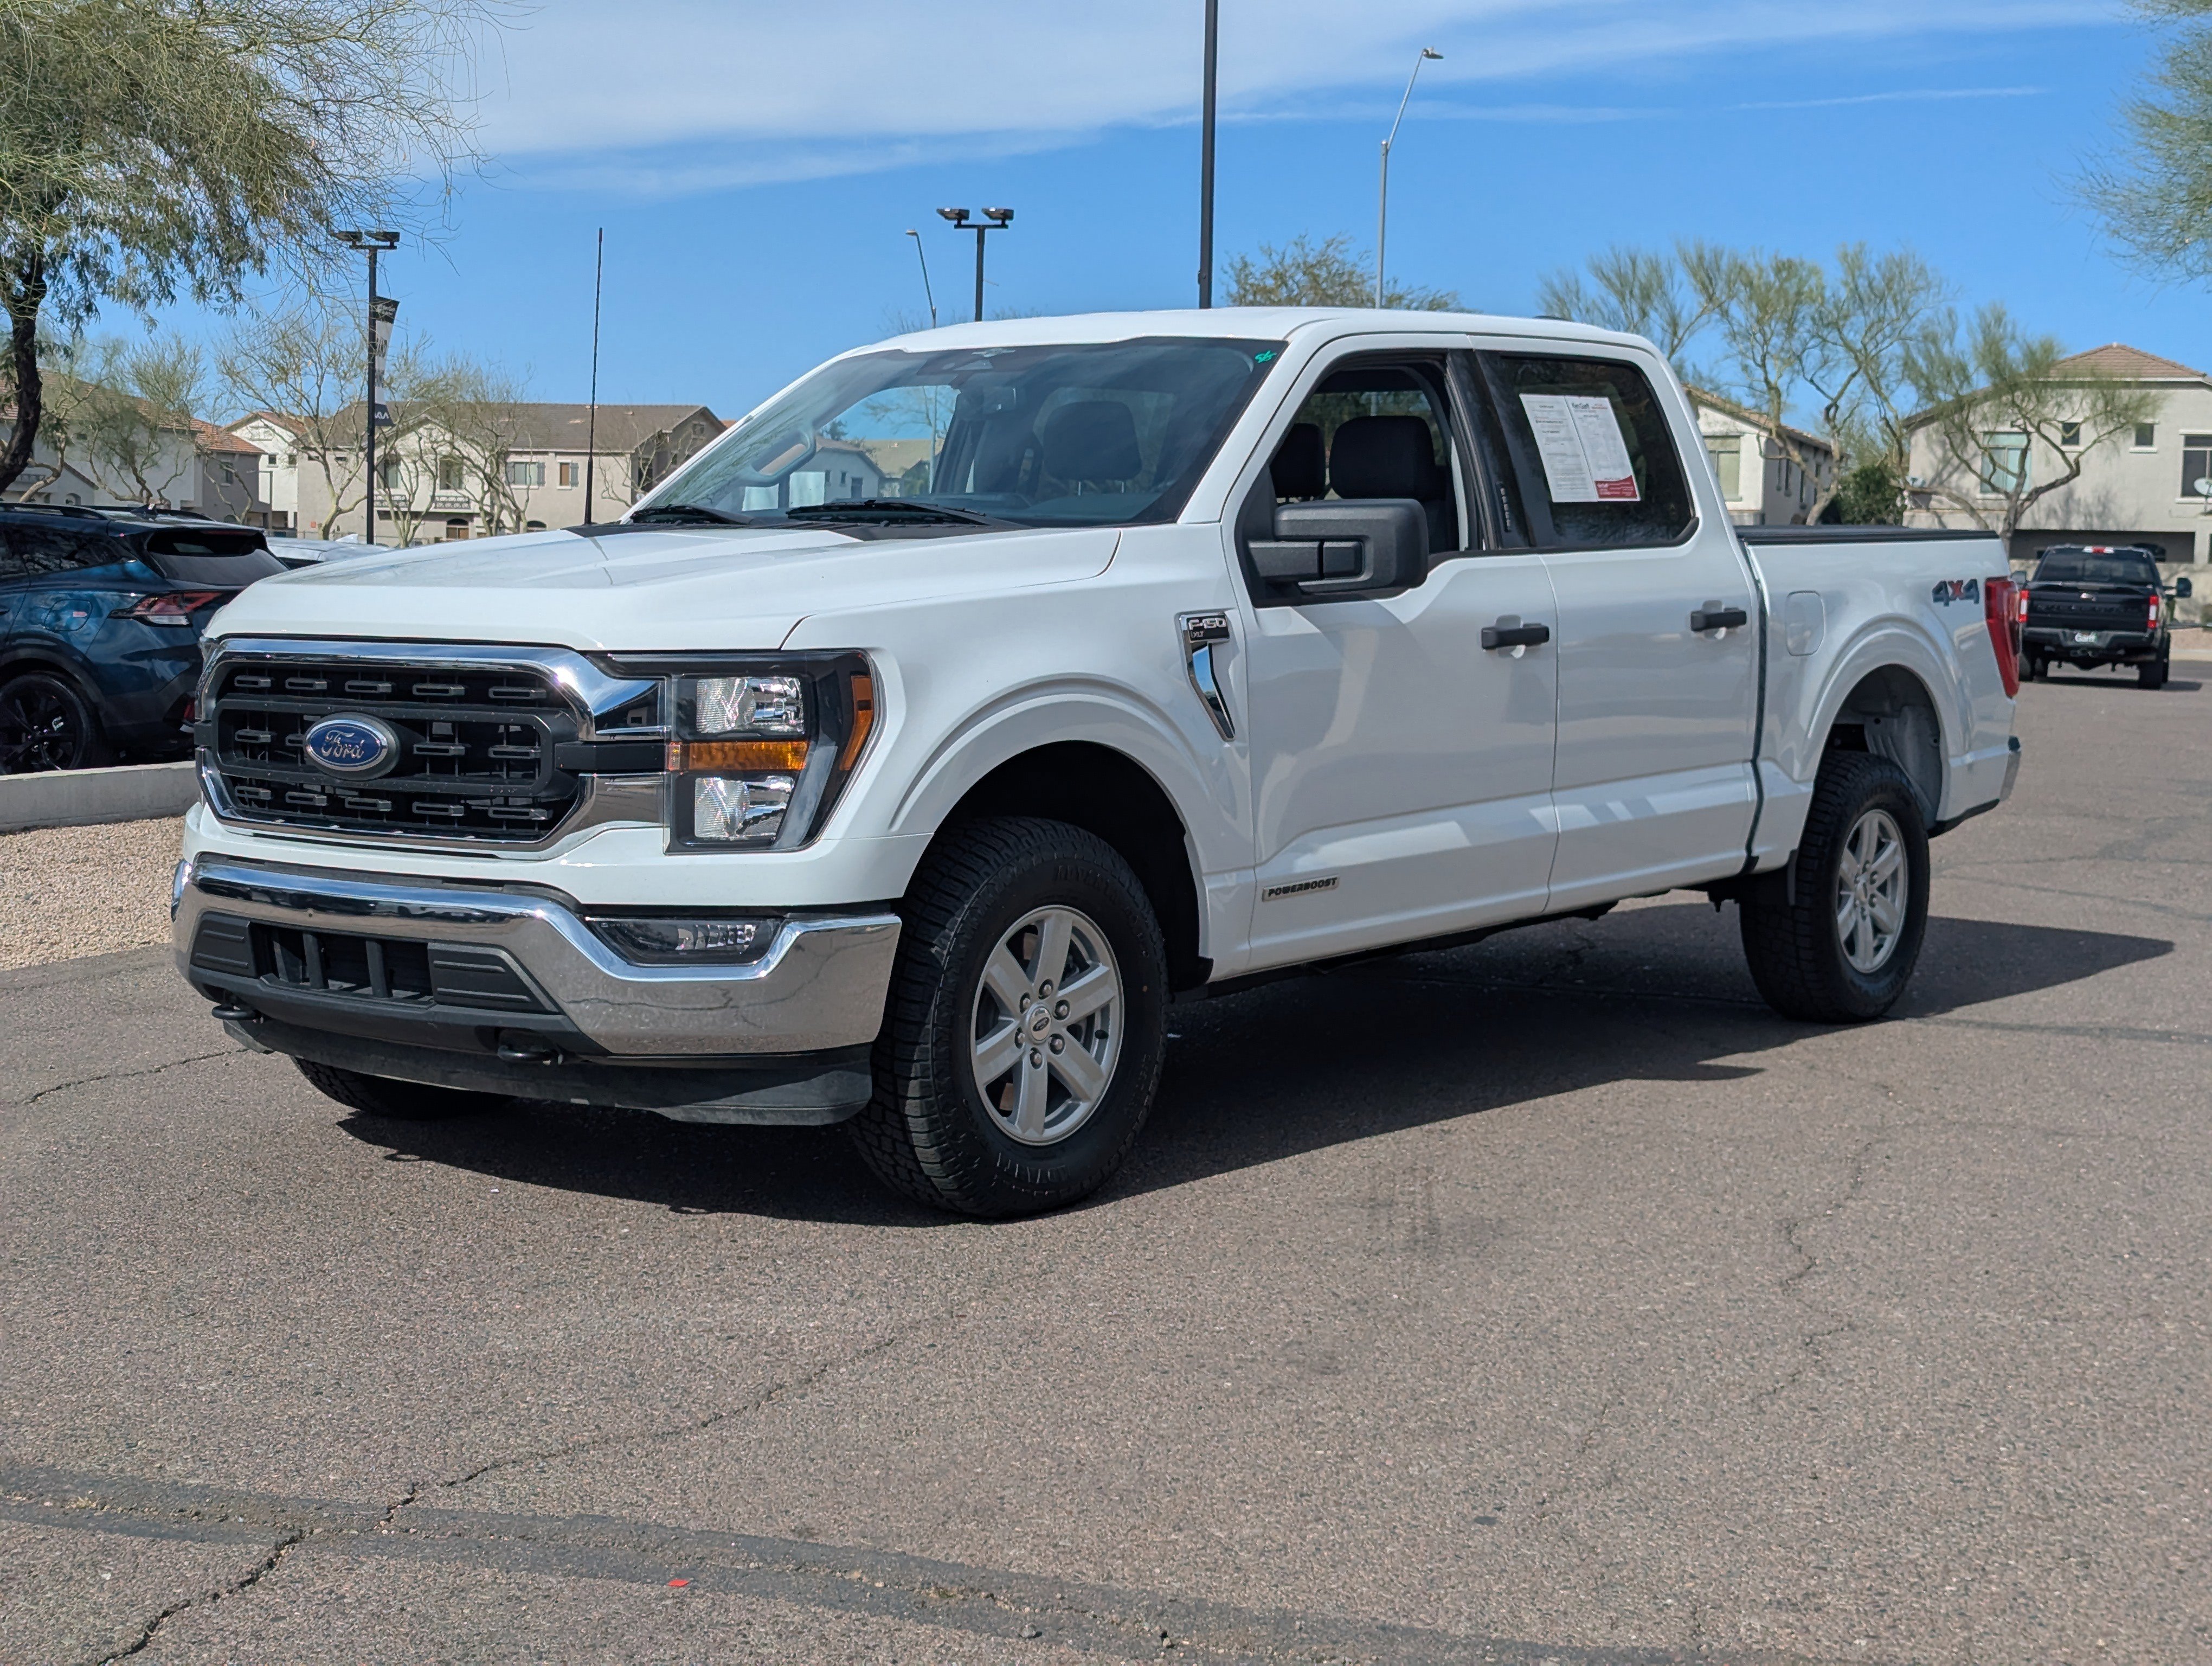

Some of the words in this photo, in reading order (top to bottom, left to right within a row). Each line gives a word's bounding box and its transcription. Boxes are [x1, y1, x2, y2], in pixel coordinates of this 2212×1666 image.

[1188, 617, 1227, 630] F-150
[321, 729, 365, 759] Ford
[1268, 876, 1338, 897] POWERBOOST
